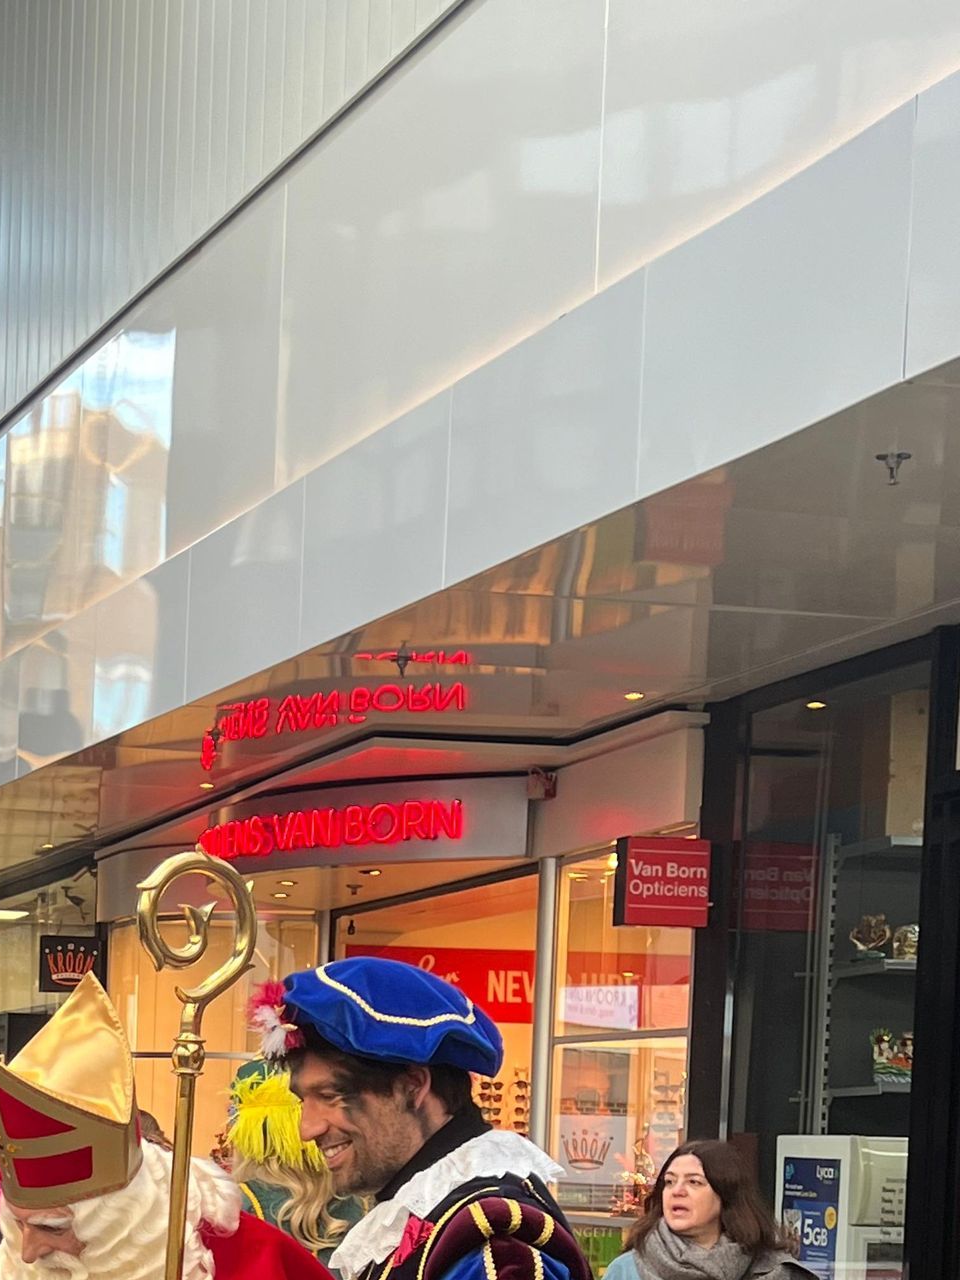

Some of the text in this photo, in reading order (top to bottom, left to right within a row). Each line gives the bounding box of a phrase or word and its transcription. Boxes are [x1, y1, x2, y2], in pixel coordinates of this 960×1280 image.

[273, 807, 339, 850] VAN
[344, 799, 464, 844] BORN
[629, 859, 708, 879] Van Born
[629, 879, 708, 898] Opticiens
[47, 951, 95, 976] KROON
[487, 969, 535, 1004] NEV
[563, 1137, 612, 1163] KROON
[802, 1218, 828, 1246] 5GB
